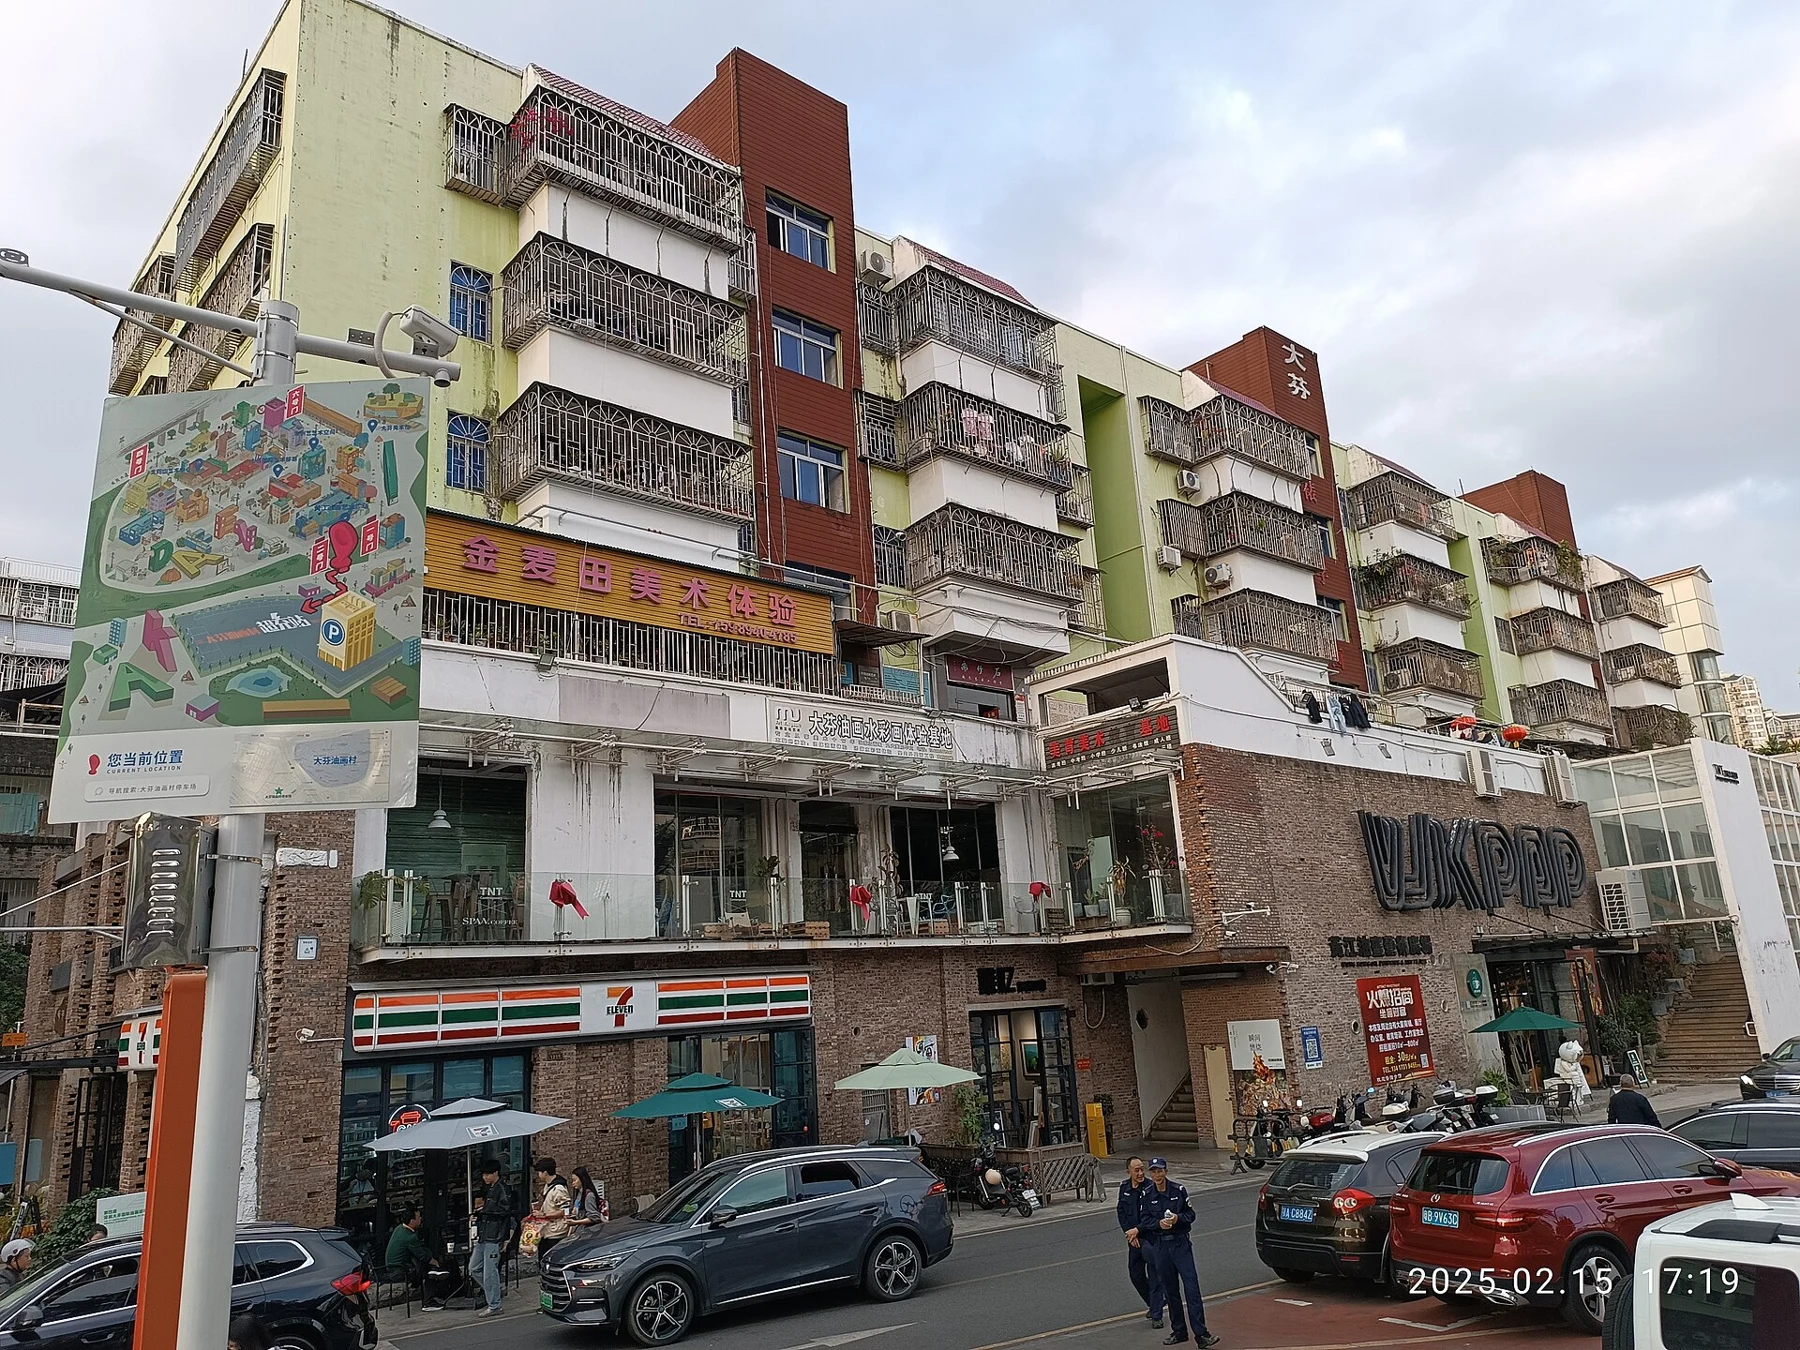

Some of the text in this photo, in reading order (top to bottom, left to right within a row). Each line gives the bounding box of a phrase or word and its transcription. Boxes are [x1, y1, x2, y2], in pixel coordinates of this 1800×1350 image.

[1282, 344, 1310, 399] 大芬
[462, 535, 798, 628] 金麦田美术体验
[808, 711, 953, 749] 大芬油画水彩画体验基地
[1140, 714, 1170, 737] 基地
[107, 750, 183, 768] 您当前位置
[144, 765, 182, 773] LOCATION
[313, 755, 357, 765] 大芬油画村
[480, 887, 503, 896] TNT
[607, 985, 634, 1027] 7
[1366, 987, 1414, 1009] 火爆招商
